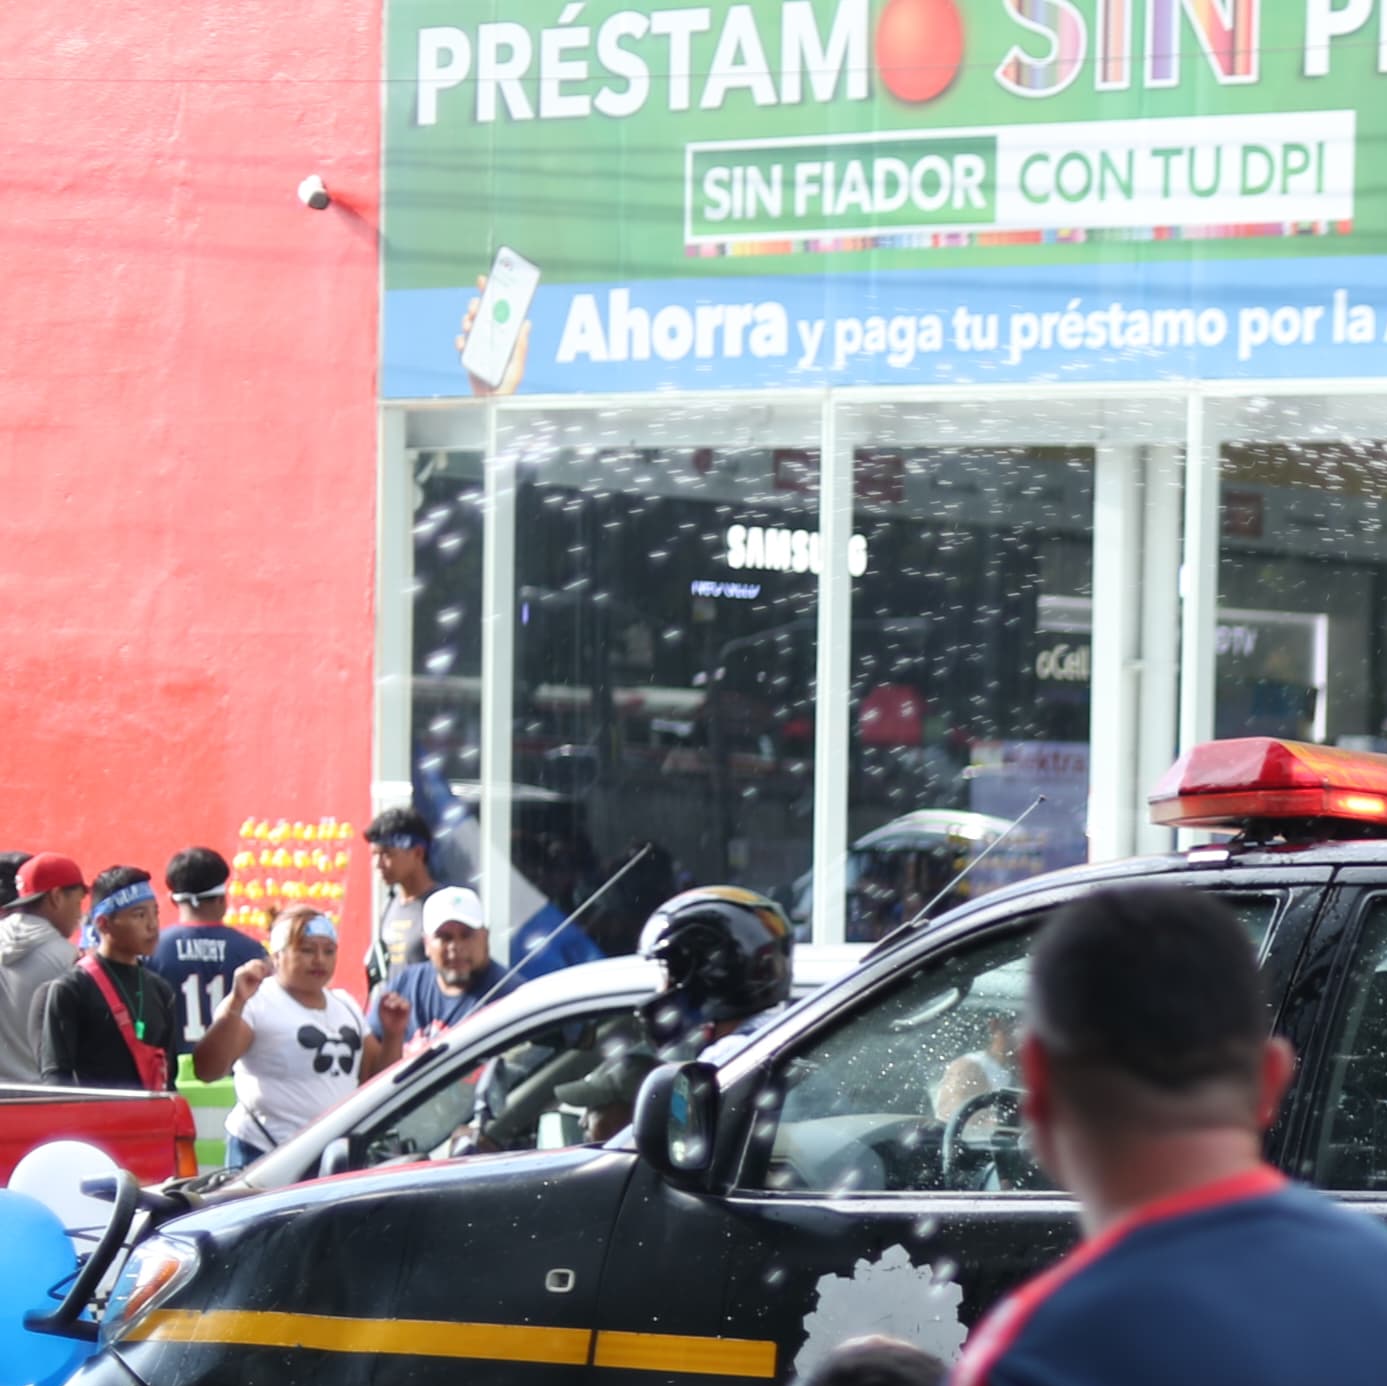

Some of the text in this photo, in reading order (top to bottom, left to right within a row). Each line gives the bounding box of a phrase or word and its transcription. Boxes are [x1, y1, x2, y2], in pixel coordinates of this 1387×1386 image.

[996, 0, 1260, 98] SIN
[702, 141, 1326, 222] SIN FIADOR CON TU DPI
[556, 289, 788, 363] Ahorra
[798, 316, 824, 368] y
[835, 310, 943, 365] paga
[952, 304, 998, 352] tu
[1009, 299, 1228, 364] préstamo
[1239, 304, 1323, 362] por
[1331, 290, 1375, 344] la
